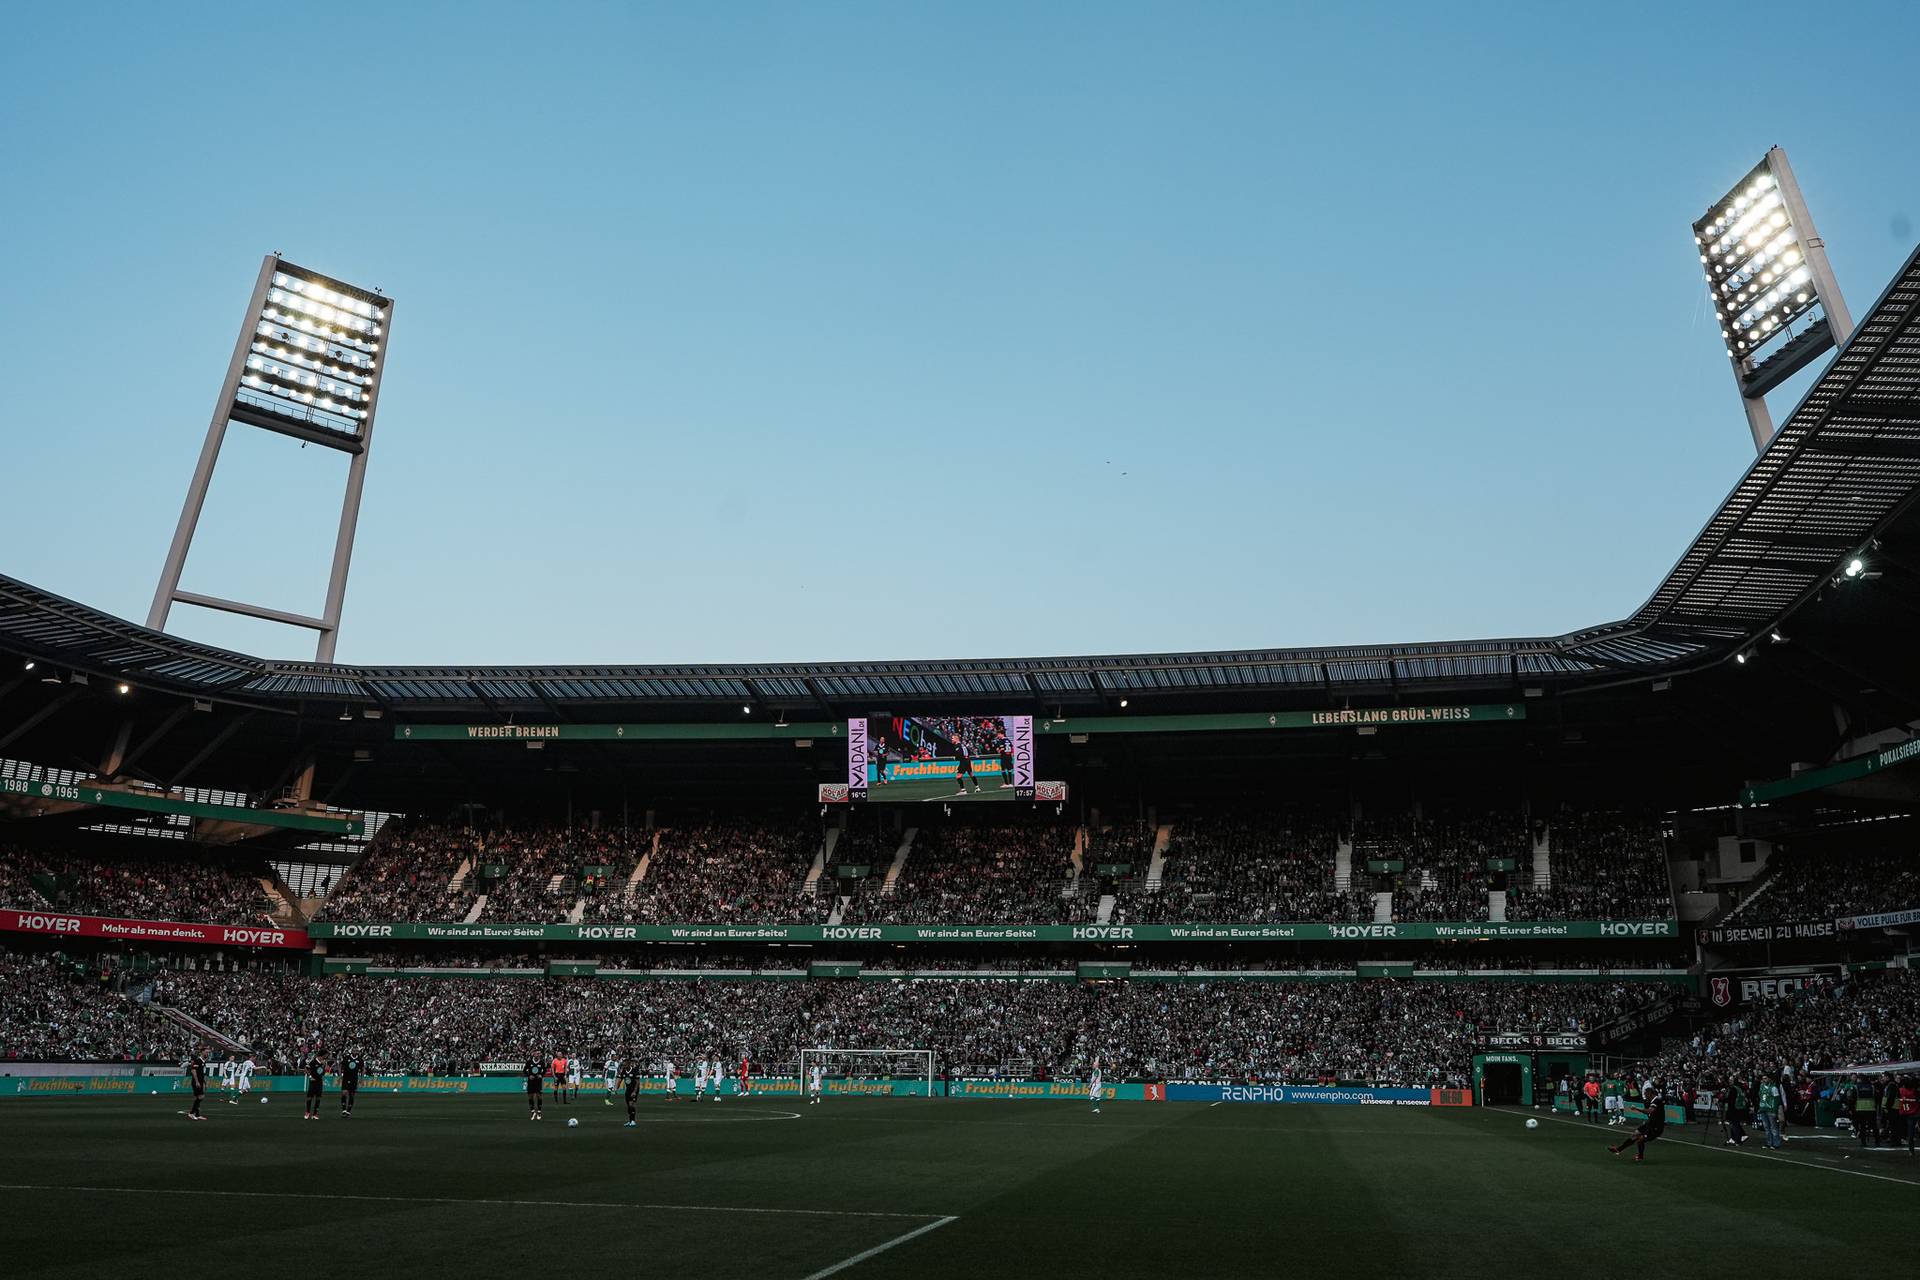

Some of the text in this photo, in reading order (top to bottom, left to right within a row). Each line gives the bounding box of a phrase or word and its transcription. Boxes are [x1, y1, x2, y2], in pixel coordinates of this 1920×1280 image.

[1312, 707, 1470, 724] LEBENSLANG GRÜN-WEISS
[468, 727, 559, 737] WERDER BREMEN
[4, 779, 28, 793] 1988
[55, 786, 79, 799] 1965
[1016, 789, 1033, 797] 17:57
[18, 915, 81, 932] HOYER
[1857, 917, 1880, 927] VOLLE
[1881, 914, 1899, 925] PULLE
[102, 924, 205, 938] Mehr als man denkt.
[333, 925, 392, 936] HOYER
[428, 928, 444, 936] Wir
[446, 928, 468, 936] sind
[484, 928, 511, 936] Eurer
[513, 928, 543, 936] Seite!
[578, 926, 637, 938] HOYER
[672, 929, 688, 937] Wir
[690, 929, 712, 937] sind
[728, 929, 755, 937] Eurer
[757, 929, 787, 937] Seite!
[822, 927, 882, 939] HOYER
[918, 929, 934, 938] Wir
[936, 929, 959, 938] sind
[975, 929, 1003, 938] Eurer
[1005, 929, 1036, 938] Seite!
[1072, 927, 1133, 939] HOYER
[1171, 928, 1188, 937] Wir
[1190, 928, 1214, 937] sind
[1231, 928, 1260, 937] Eurer
[1262, 928, 1294, 937] Seite!
[1332, 925, 1397, 938] HOYER
[1436, 926, 1454, 935] Wir
[1456, 926, 1481, 935] sind
[1500, 926, 1531, 935] Eurer
[1533, 926, 1567, 935] Seite!
[1600, 923, 1669, 935] HOYER
[1775, 925, 1791, 939] ZU
[1794, 922, 1833, 938] HAUSE
[223, 929, 285, 944] HOYER
[1741, 978, 1802, 1001] BEC
[408, 1078, 468, 1091] Hulsberg
[965, 1083, 1117, 1098] Fruchthaus Hulsbrg
[1222, 1087, 1284, 1101] RENPHO
[1291, 1089, 1373, 1102] www.renpho.com
